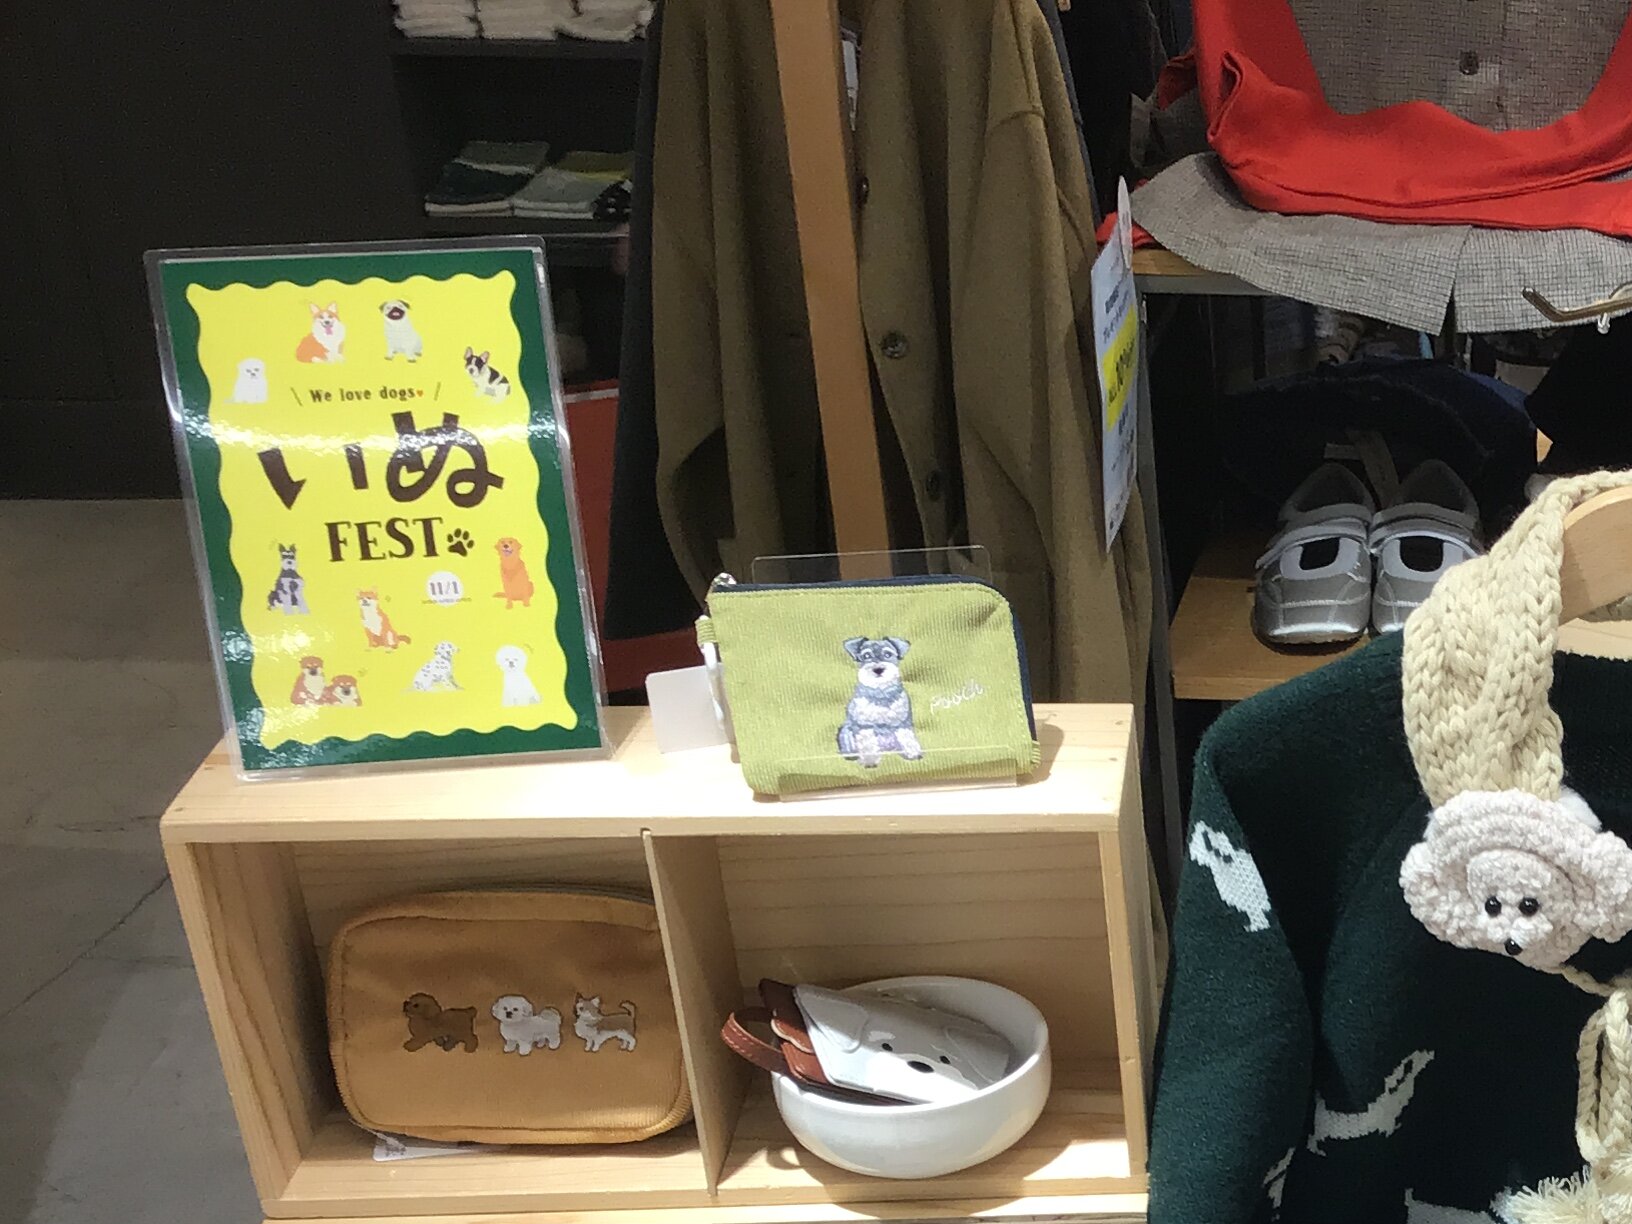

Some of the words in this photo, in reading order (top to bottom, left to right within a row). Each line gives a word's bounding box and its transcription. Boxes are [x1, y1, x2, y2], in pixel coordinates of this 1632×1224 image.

[309, 389, 332, 403] We
[339, 387, 372, 402] love
[379, 385, 416, 402] dogs
[257, 410, 505, 511] いぬ
[325, 516, 443, 562] FEST
